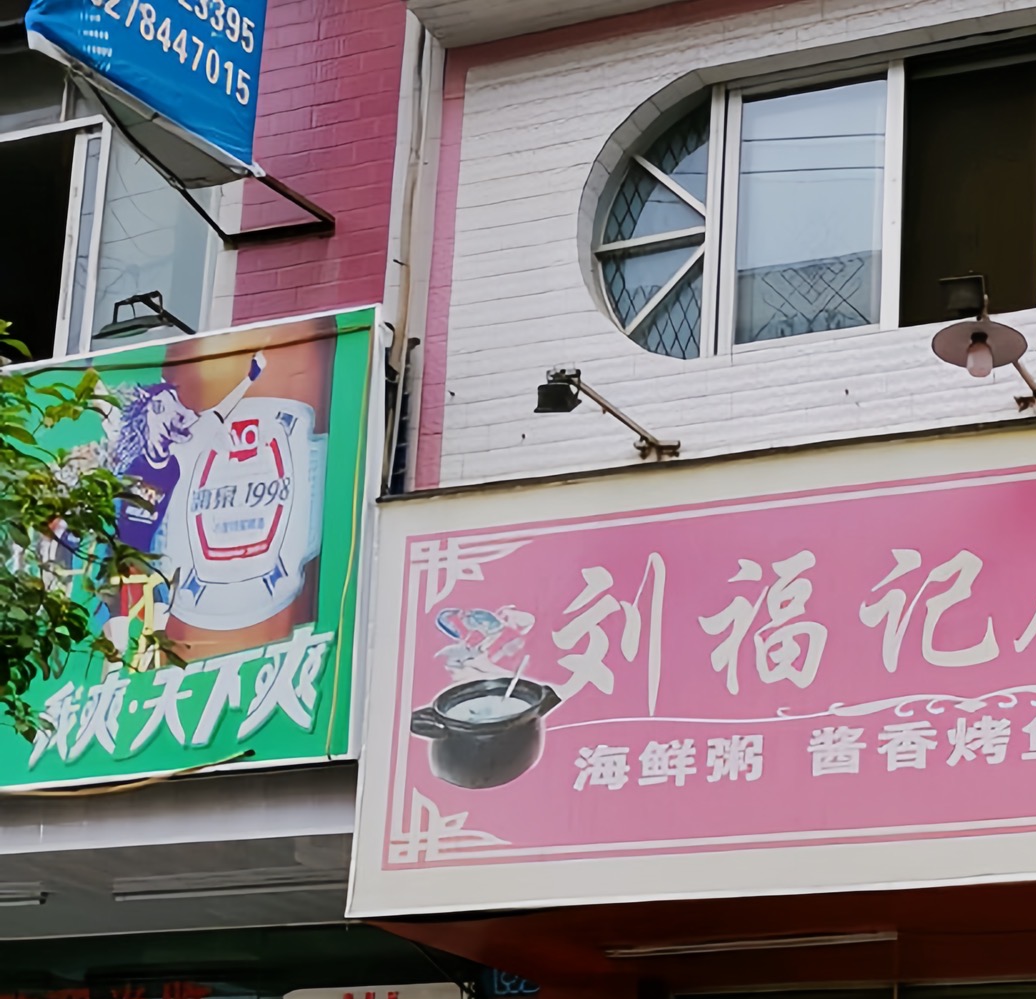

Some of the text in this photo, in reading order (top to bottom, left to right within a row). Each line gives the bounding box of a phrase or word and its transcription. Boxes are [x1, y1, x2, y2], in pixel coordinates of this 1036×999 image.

[244, 477, 291, 507] 1998
[574, 733, 764, 791] 海鲜粥
